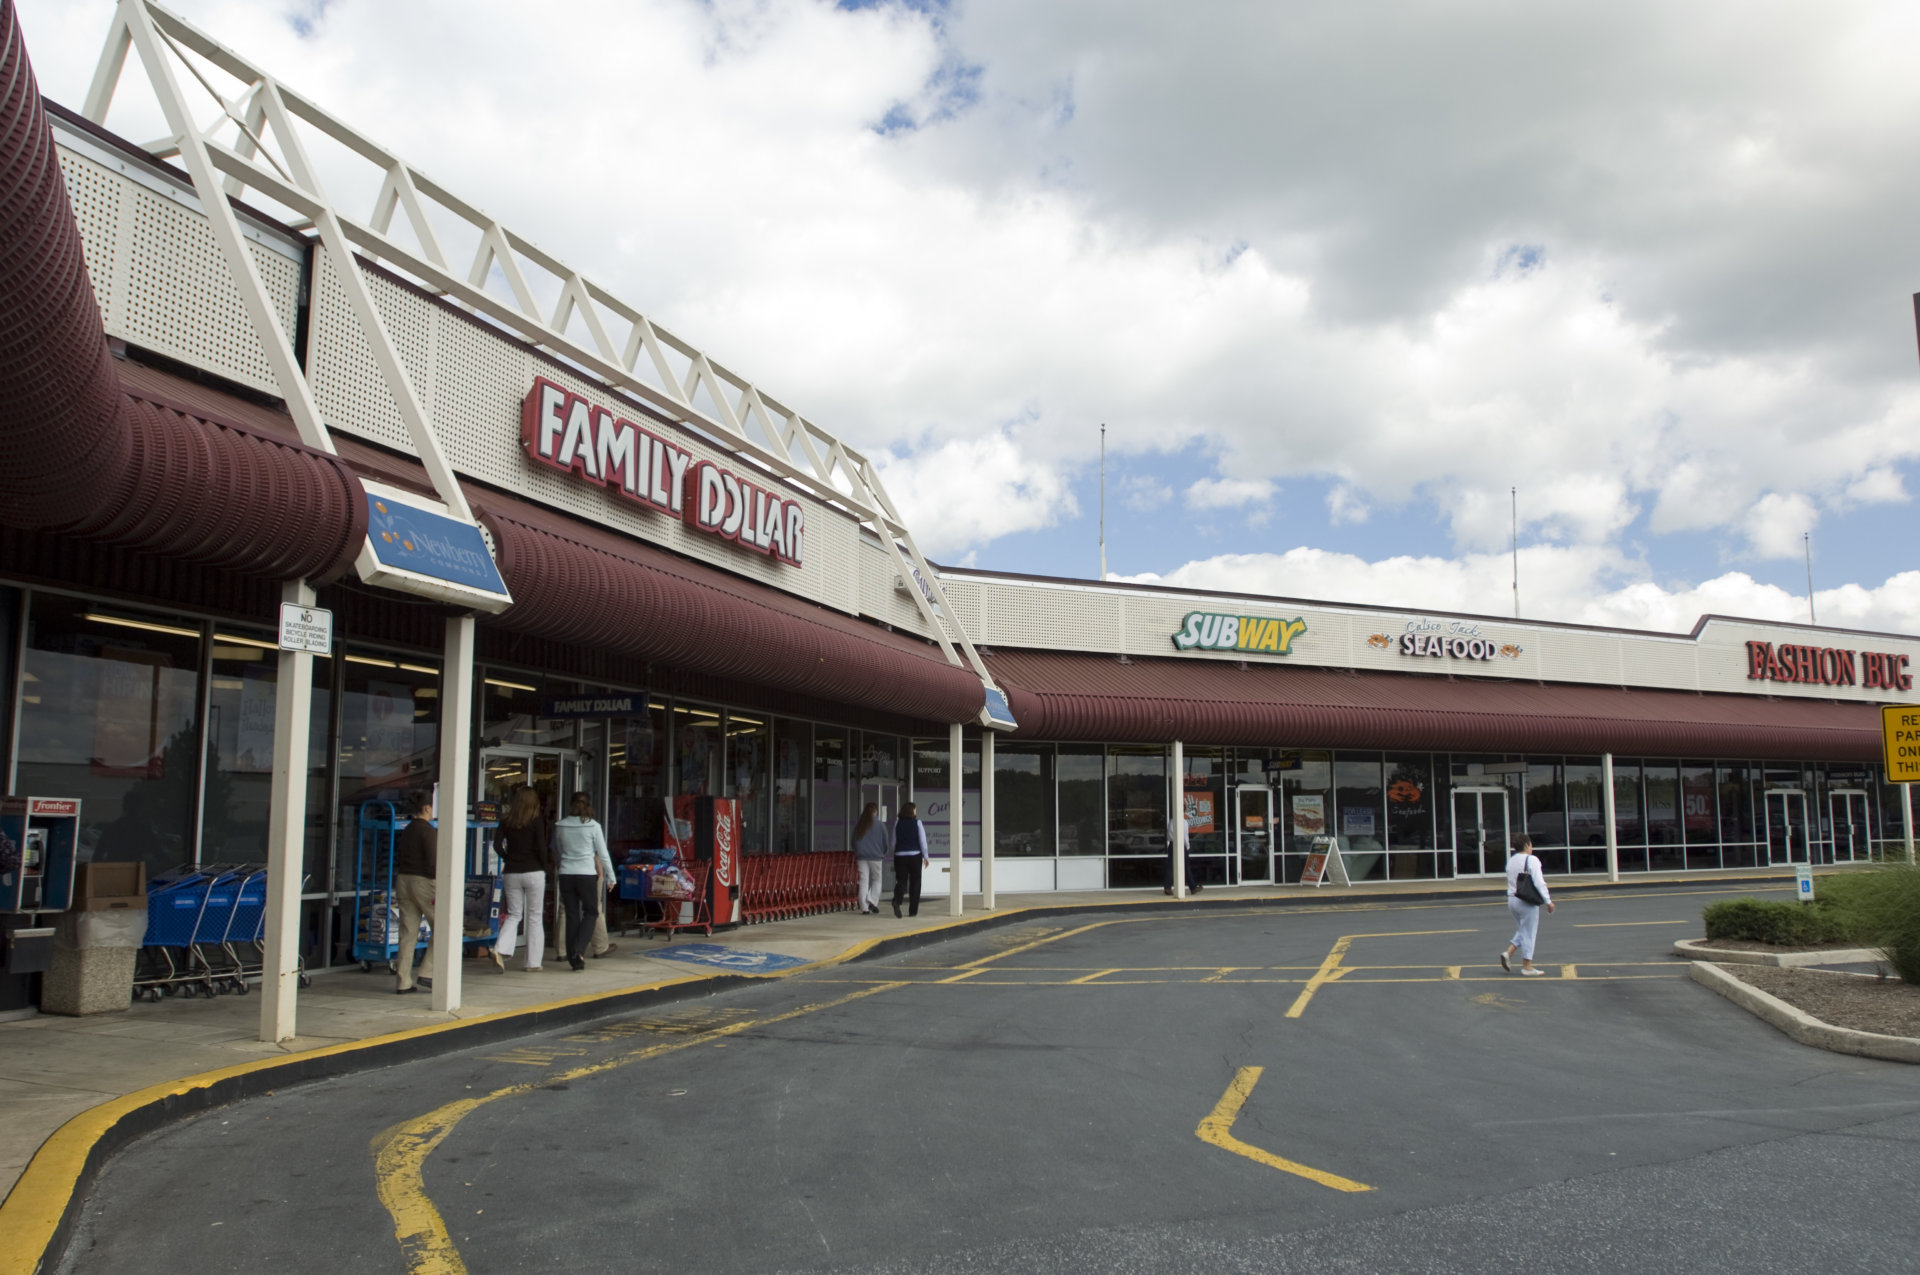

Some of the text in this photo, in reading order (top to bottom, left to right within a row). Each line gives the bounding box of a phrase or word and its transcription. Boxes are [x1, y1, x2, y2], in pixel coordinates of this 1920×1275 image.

[536, 383, 804, 564] FAMILY DOLLAR
[408, 528, 488, 578] Newberry
[301, 612, 313, 623] NO
[285, 621, 328, 633] SKATEBOARDING
[1176, 613, 1307, 652] SUBWAY
[1406, 619, 1442, 633] Calico
[283, 635, 304, 643] ROLLER
[285, 629, 307, 637] BICYCLE
[1400, 633, 1498, 660] SEAFOOD
[1746, 641, 1914, 692] FASHION BUG
[553, 698, 633, 713] FAMILY DOLLAR
[1901, 715, 1920, 726] RE
[1898, 746, 1920, 757] ON
[1896, 761, 1920, 773] THI
